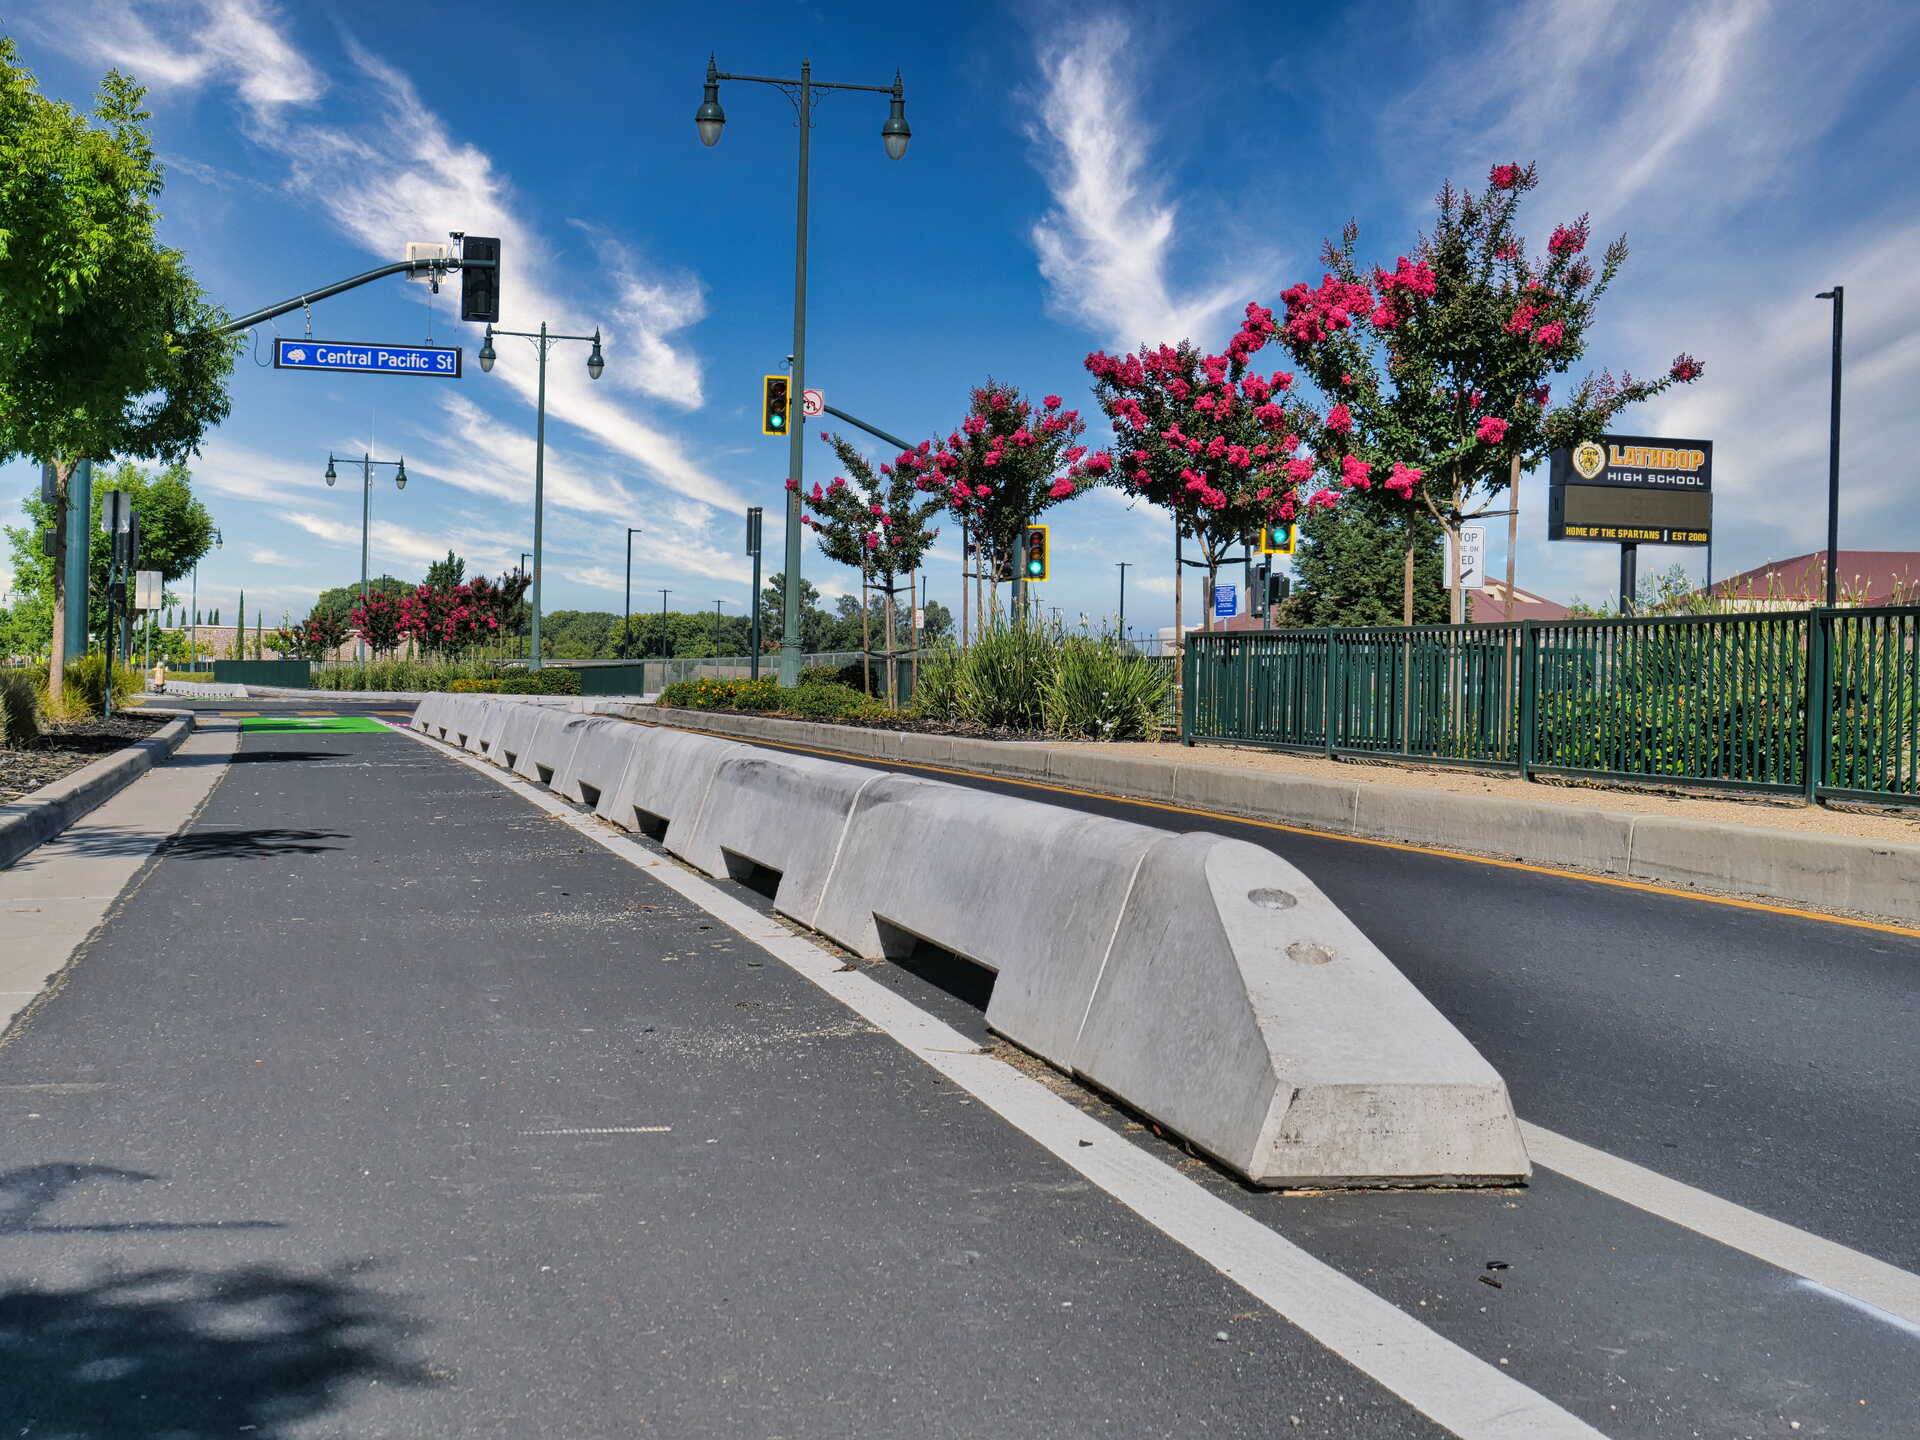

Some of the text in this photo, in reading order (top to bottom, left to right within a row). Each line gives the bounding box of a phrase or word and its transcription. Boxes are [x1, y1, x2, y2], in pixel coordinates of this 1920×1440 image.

[316, 348, 452, 370] Central Pacific St
[1609, 445, 1705, 472] LATHROP
[1607, 472, 1704, 486] HIGH SCHOOL
[1459, 532, 1478, 542] TOP
[1566, 526, 1588, 537] HOME
[1589, 527, 1599, 537] OF
[1601, 528, 1617, 538] THE
[1618, 528, 1660, 540] SPARTANS
[1672, 531, 1687, 541] EST
[1461, 555, 1474, 565] ED
